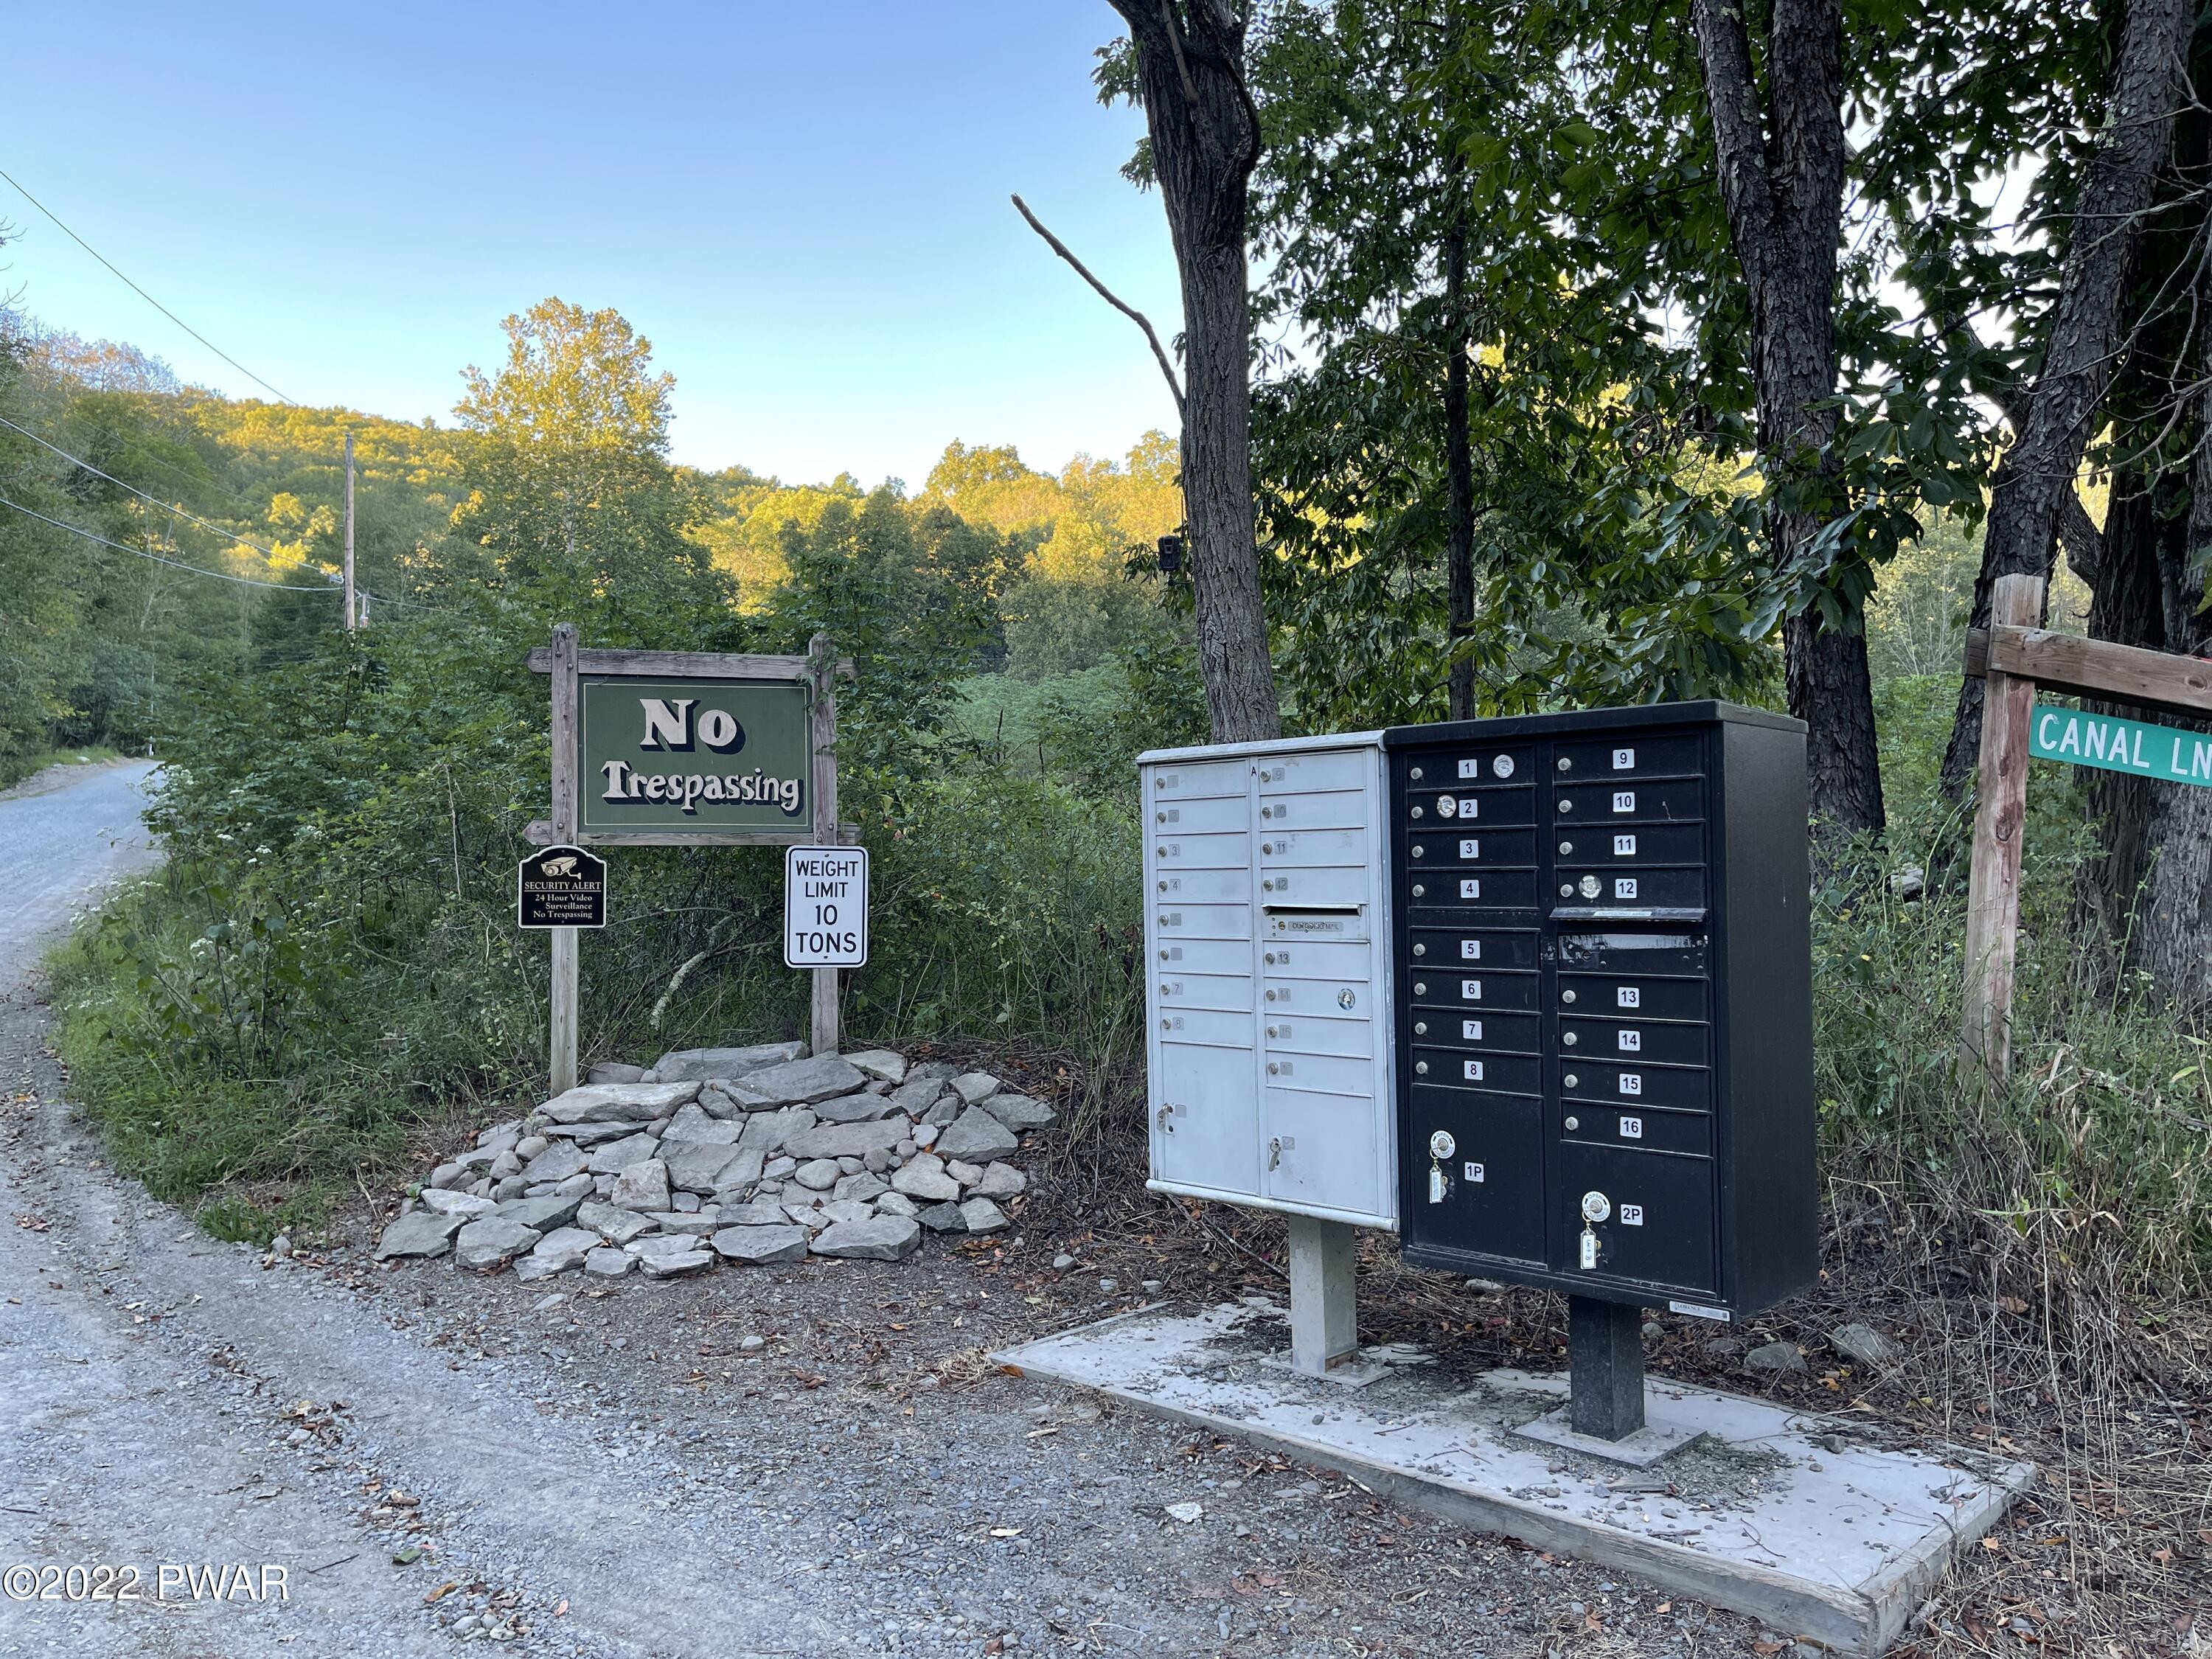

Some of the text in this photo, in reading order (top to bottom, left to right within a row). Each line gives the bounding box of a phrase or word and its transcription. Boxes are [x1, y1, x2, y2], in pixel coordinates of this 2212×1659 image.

[639, 698, 740, 749] No
[2039, 714, 2212, 780] CANAL LN
[1619, 752, 1627, 765] 9
[1251, 766, 1257, 777] A
[1464, 762, 1470, 773] 1
[600, 760, 799, 812] Trespassing
[1616, 795, 1632, 807] 10
[1464, 802, 1472, 814] 2
[1277, 843, 1285, 854] 11
[1466, 842, 1473, 855] 3
[1617, 838, 1631, 851] 11
[1172, 846, 1178, 856] 3
[796, 860, 859, 877] WEIGHT
[524, 881, 602, 890] SECURITY ALERT
[805, 881, 849, 898] LIMIT
[1172, 880, 1178, 891] 4
[1278, 879, 1287, 890] 12
[1466, 882, 1474, 894] 4
[1618, 881, 1634, 894] 12
[535, 893, 593, 902] 24 Hour Video
[545, 902, 593, 910] Surveillance
[533, 910, 593, 919] No Trespassing
[815, 904, 838, 926] 10
[795, 931, 857, 953] TONS
[1467, 943, 1475, 955] 5
[1175, 984, 1180, 992] 7
[1468, 983, 1475, 995] 6
[1621, 990, 1636, 1004] 13
[1176, 1019, 1181, 1029] 8
[1468, 1023, 1475, 1035] 7
[1621, 1033, 1638, 1046] 14
[1470, 1063, 1478, 1076] 8
[1623, 1077, 1638, 1090] 15
[1623, 1120, 1639, 1133] 16
[1467, 1165, 1483, 1178] 1P
[1623, 1207, 1641, 1220] 2P
